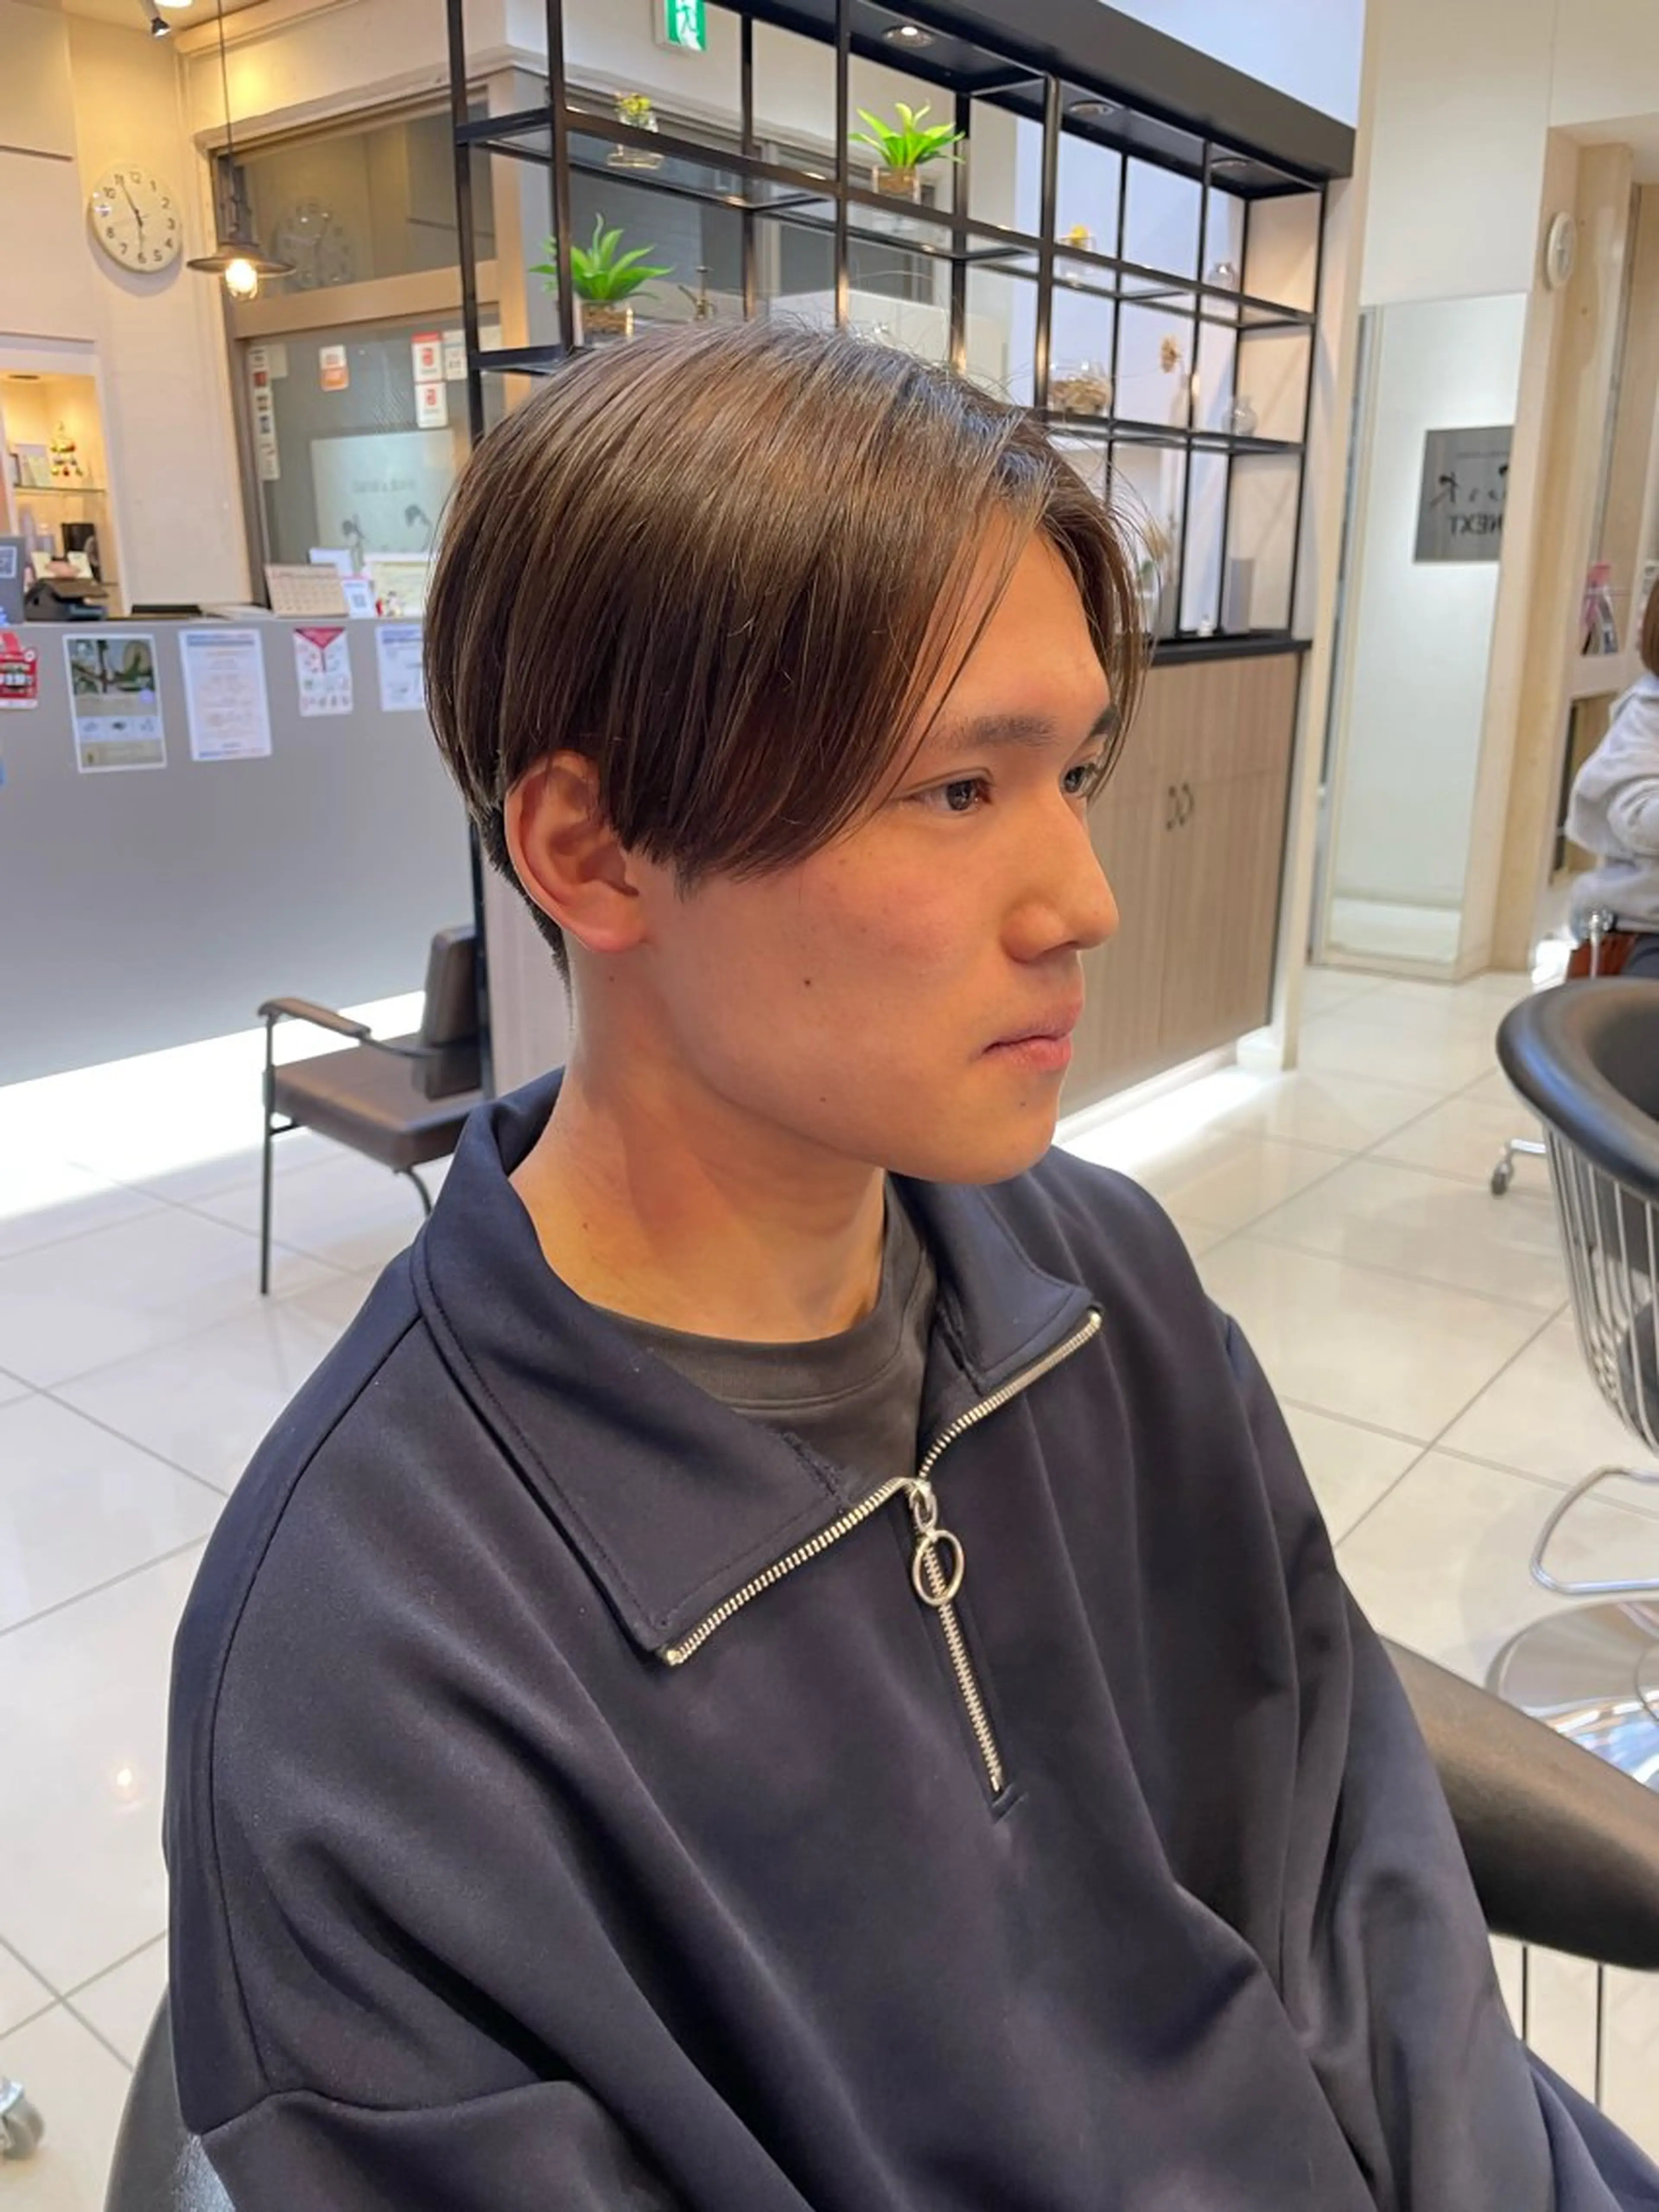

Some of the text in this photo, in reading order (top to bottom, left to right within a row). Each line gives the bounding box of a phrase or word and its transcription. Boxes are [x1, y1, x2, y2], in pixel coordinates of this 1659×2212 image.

[150, 180, 156, 192] 1
[103, 187, 116, 199] 10
[162, 197, 170, 209] 2
[168, 218, 175, 230] 3
[107, 227, 115, 238] 8
[119, 242, 127, 255] 7
[165, 238, 172, 248] 4
[138, 252, 147, 264] 6
[153, 249, 163, 261] 5
